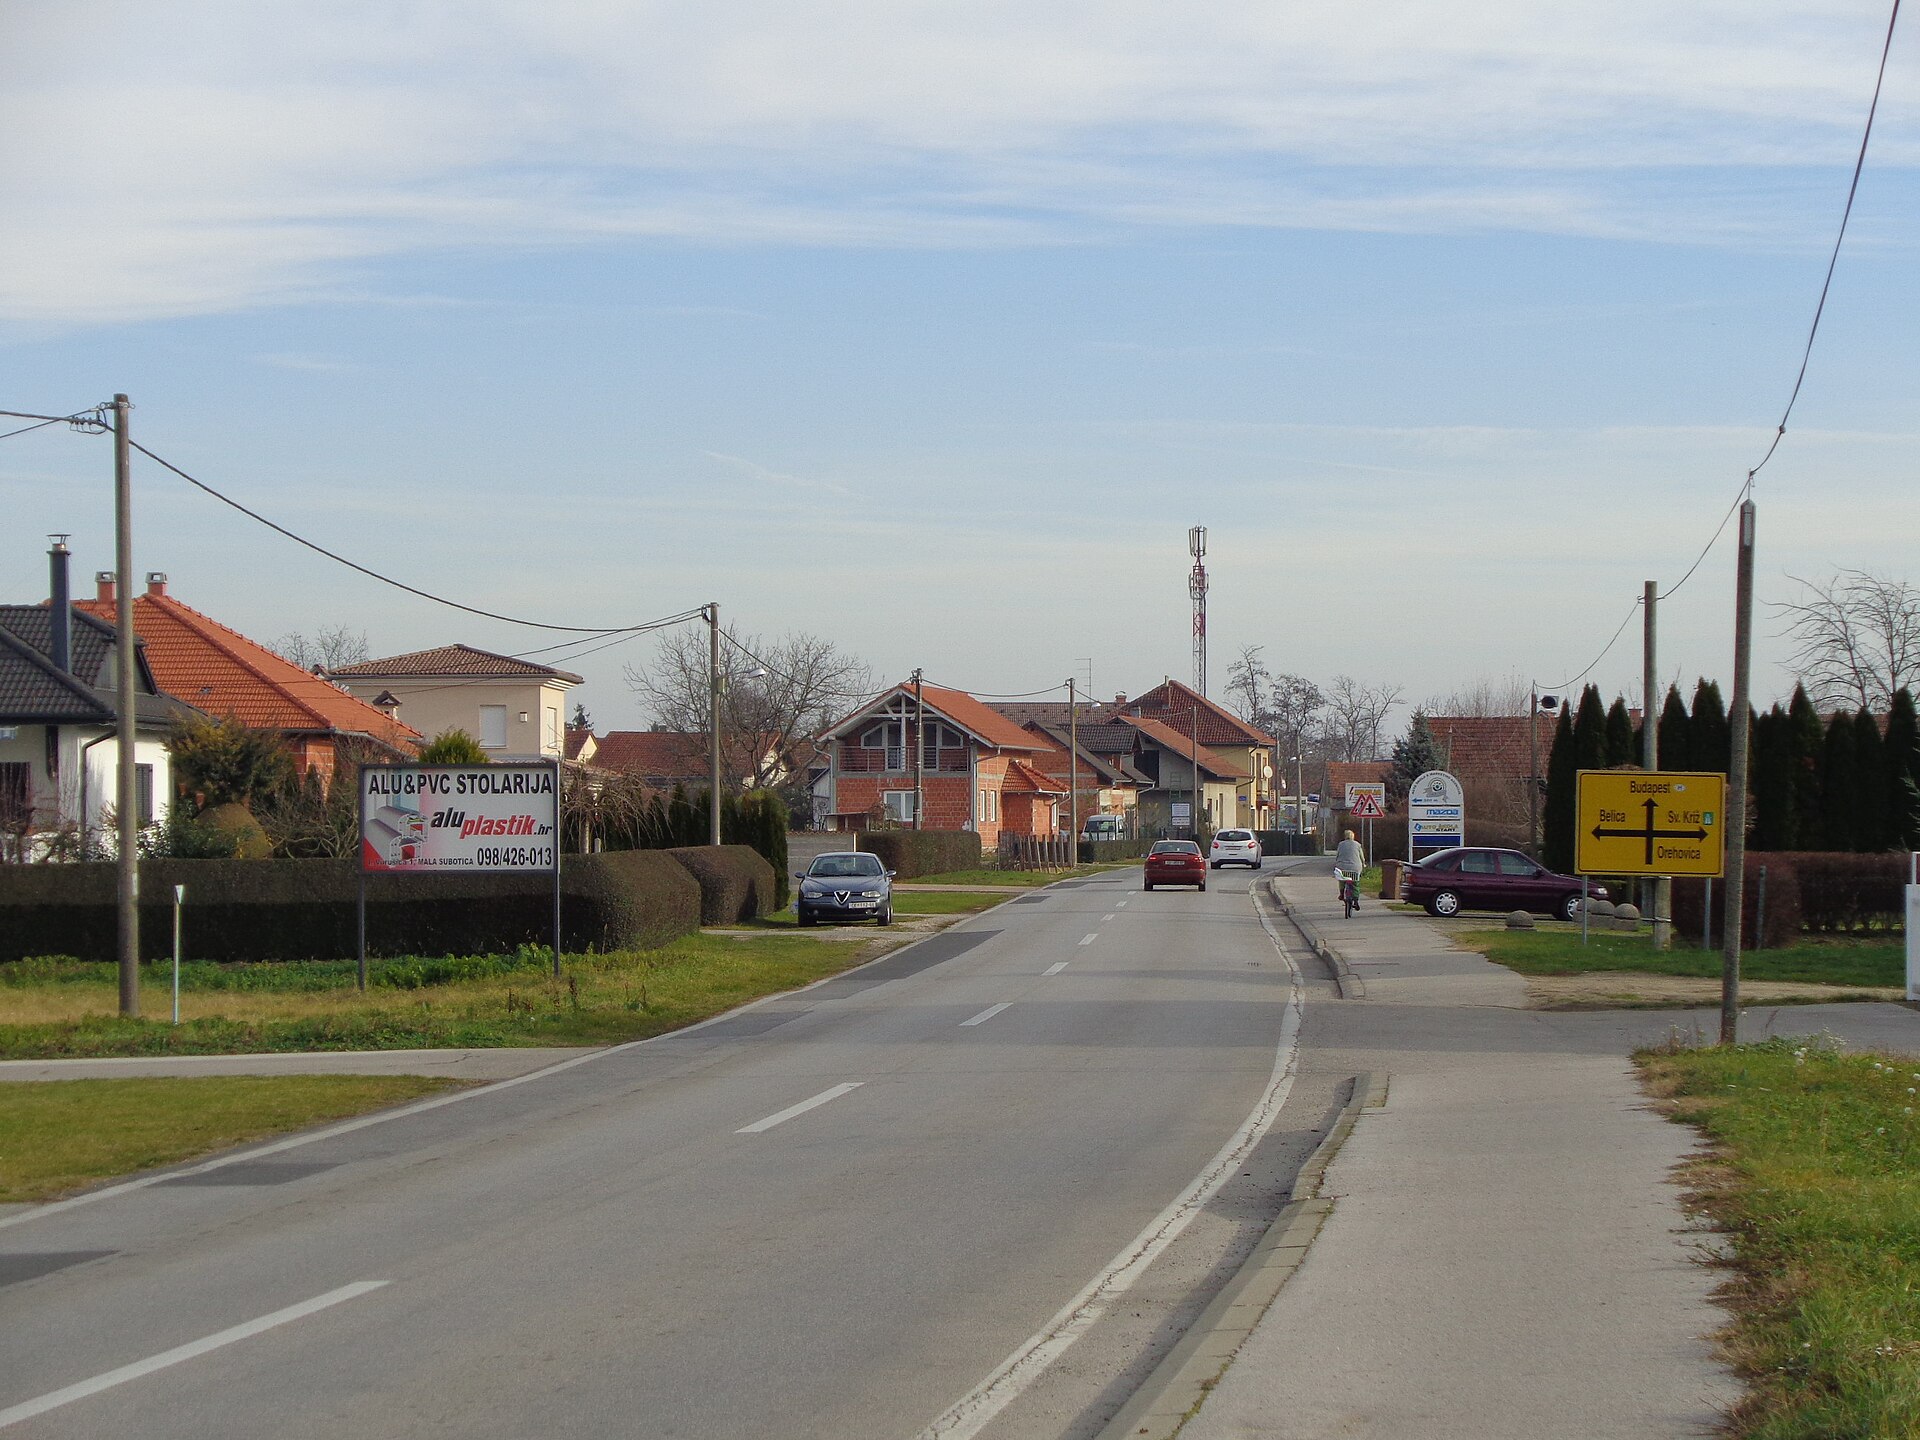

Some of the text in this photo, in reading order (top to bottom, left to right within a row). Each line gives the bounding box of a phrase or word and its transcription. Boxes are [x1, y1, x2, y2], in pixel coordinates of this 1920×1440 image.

[368, 773, 552, 795] ALU&PVC STOLARIJA
[1630, 780, 1671, 796] Budapest
[1426, 808, 1459, 816] mazda
[1600, 809, 1626, 823] Belica
[1668, 810, 1681, 824] Sv.
[476, 847, 553, 867] 098/426-013
[1657, 845, 1701, 860] Orehovica
[418, 857, 438, 866] MALA
[438, 857, 474, 866] SUBOTICA
